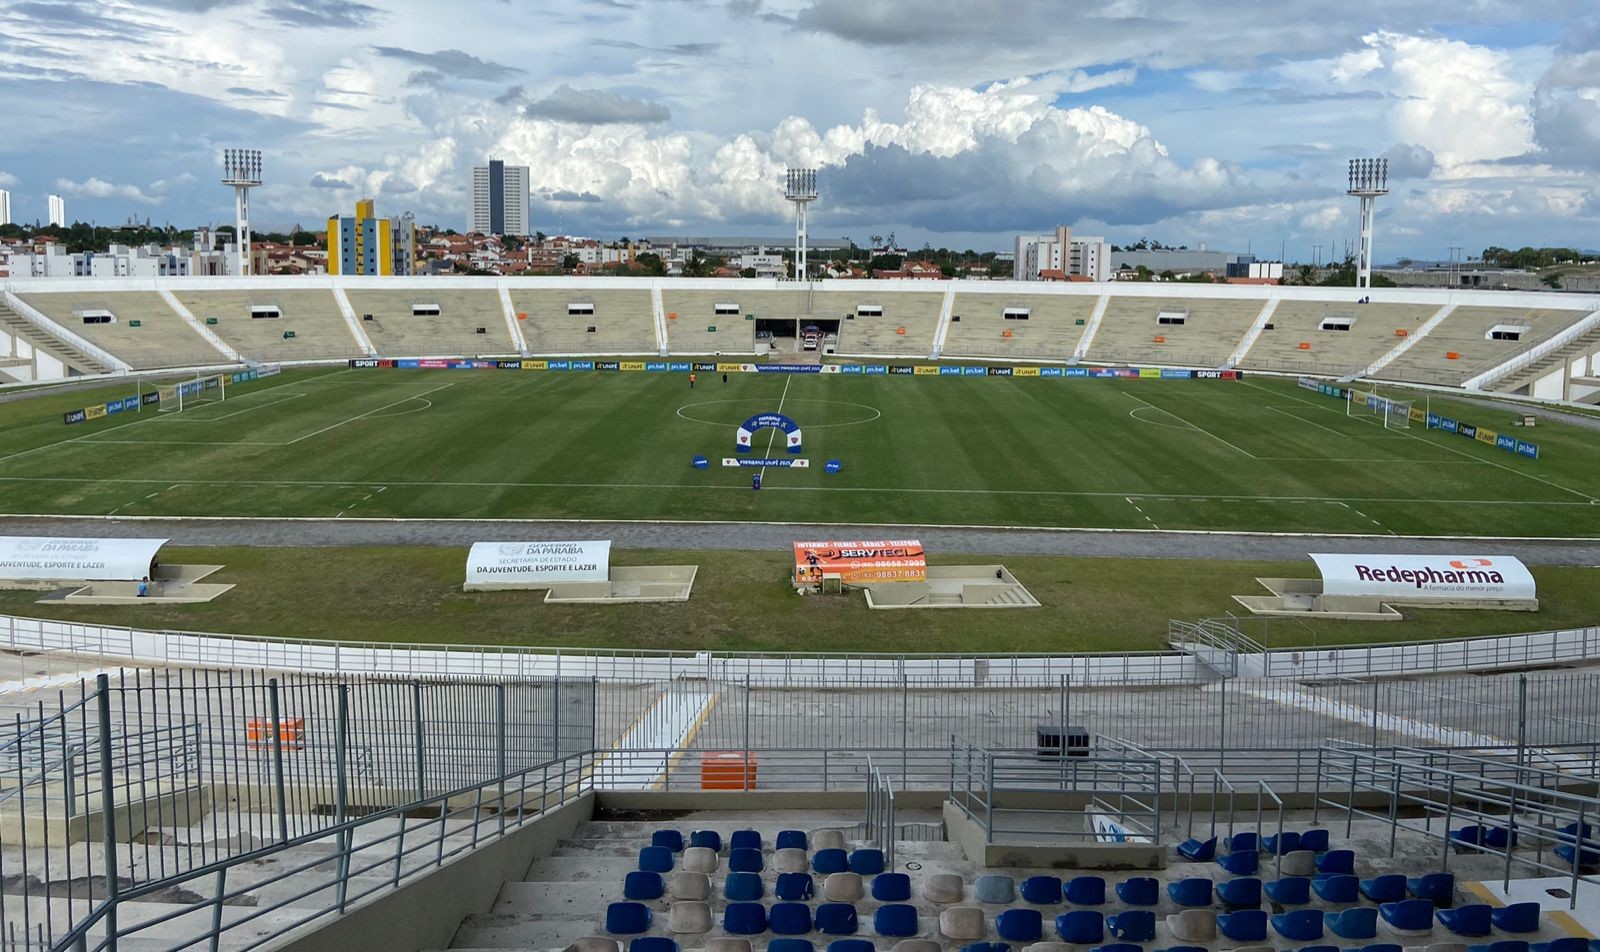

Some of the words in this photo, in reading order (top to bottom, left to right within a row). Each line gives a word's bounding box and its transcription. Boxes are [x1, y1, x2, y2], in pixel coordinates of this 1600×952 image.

[797, 541, 829, 549] INTERNET
[526, 547, 542, 555] DA
[542, 546, 584, 555] PARAÍBA
[44, 561, 75, 569] ESPORTE
[77, 561, 82, 569] E
[82, 561, 105, 569] LAZER
[489, 565, 534, 574] JUVENTUDE,
[536, 564, 568, 572] ESPORTE
[574, 563, 597, 571] LAZER
[1355, 564, 1504, 589] Redepharma
[1429, 584, 1455, 592] farmácia
